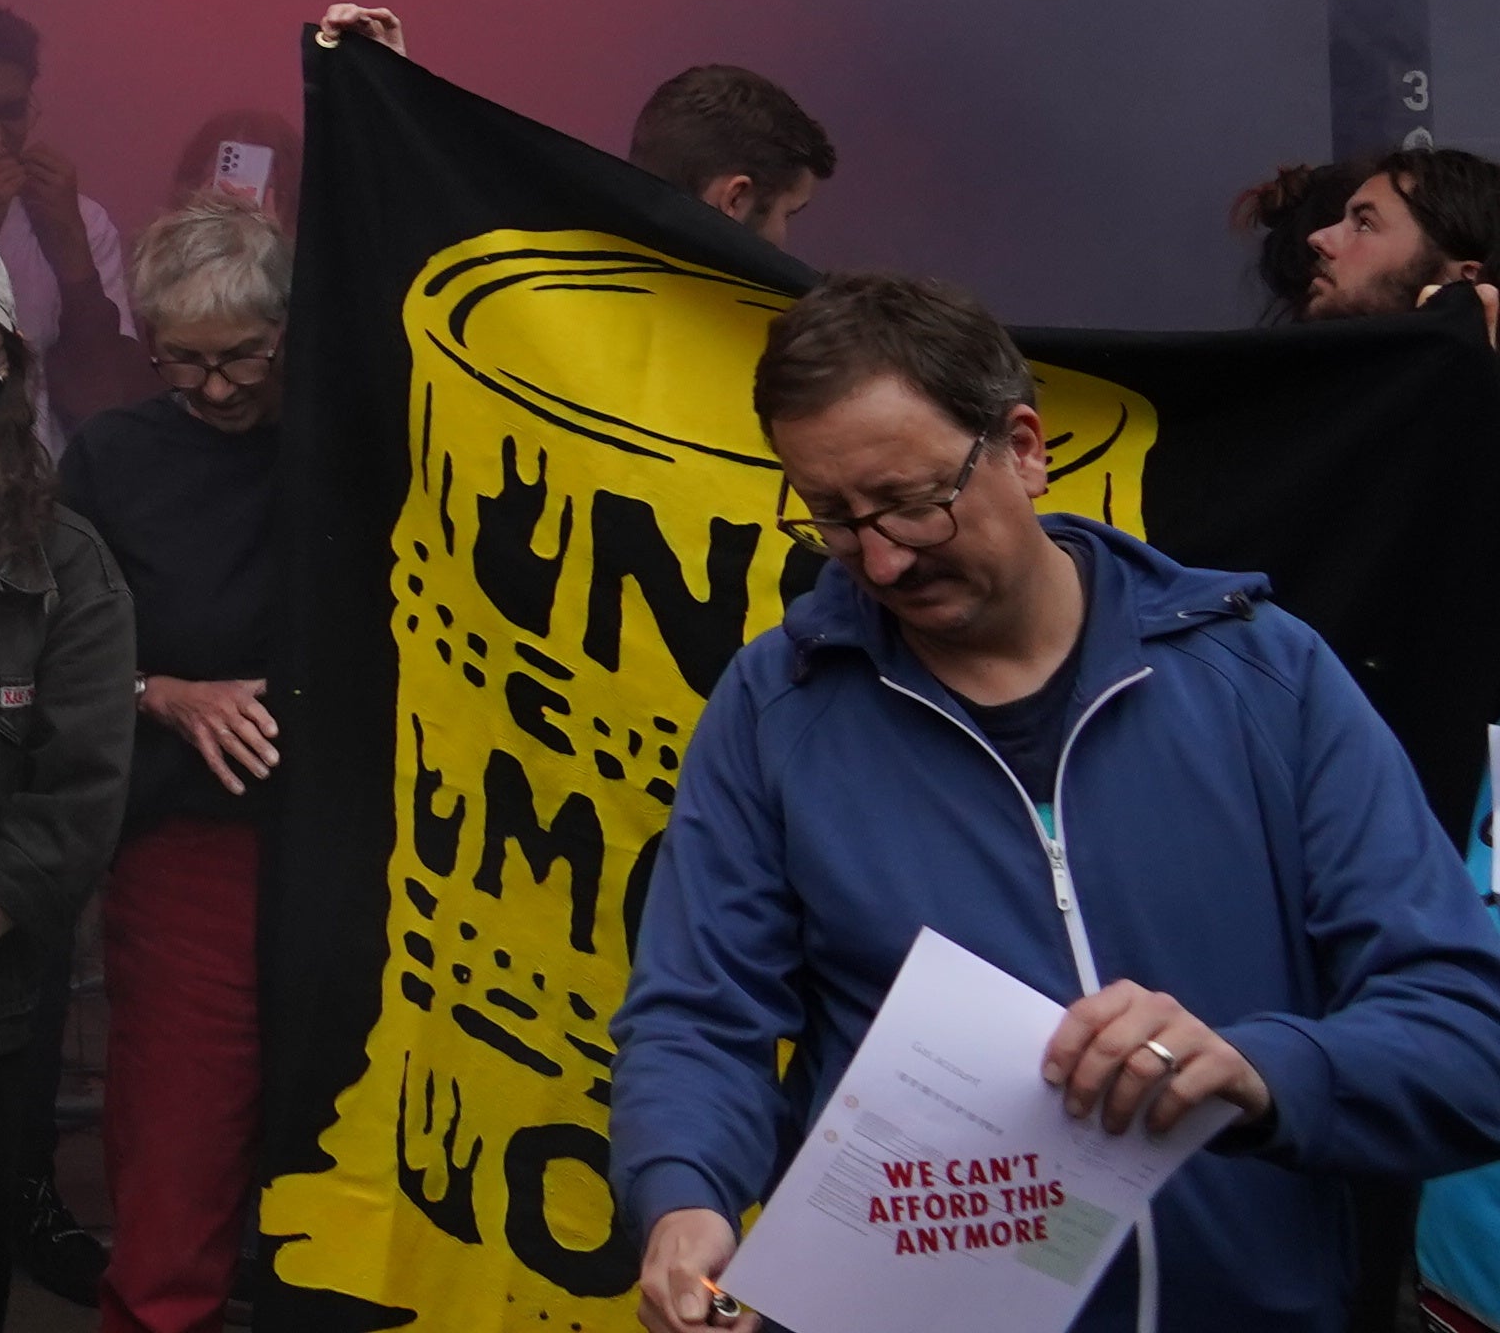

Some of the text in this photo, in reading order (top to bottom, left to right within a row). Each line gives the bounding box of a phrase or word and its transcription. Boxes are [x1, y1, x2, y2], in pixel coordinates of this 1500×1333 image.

[881, 1160, 935, 1189] WE
[945, 1152, 1040, 1187] CAN'T
[868, 1179, 1065, 1224] AFFORD THIS
[895, 1215, 1049, 1256] ANYMORE
